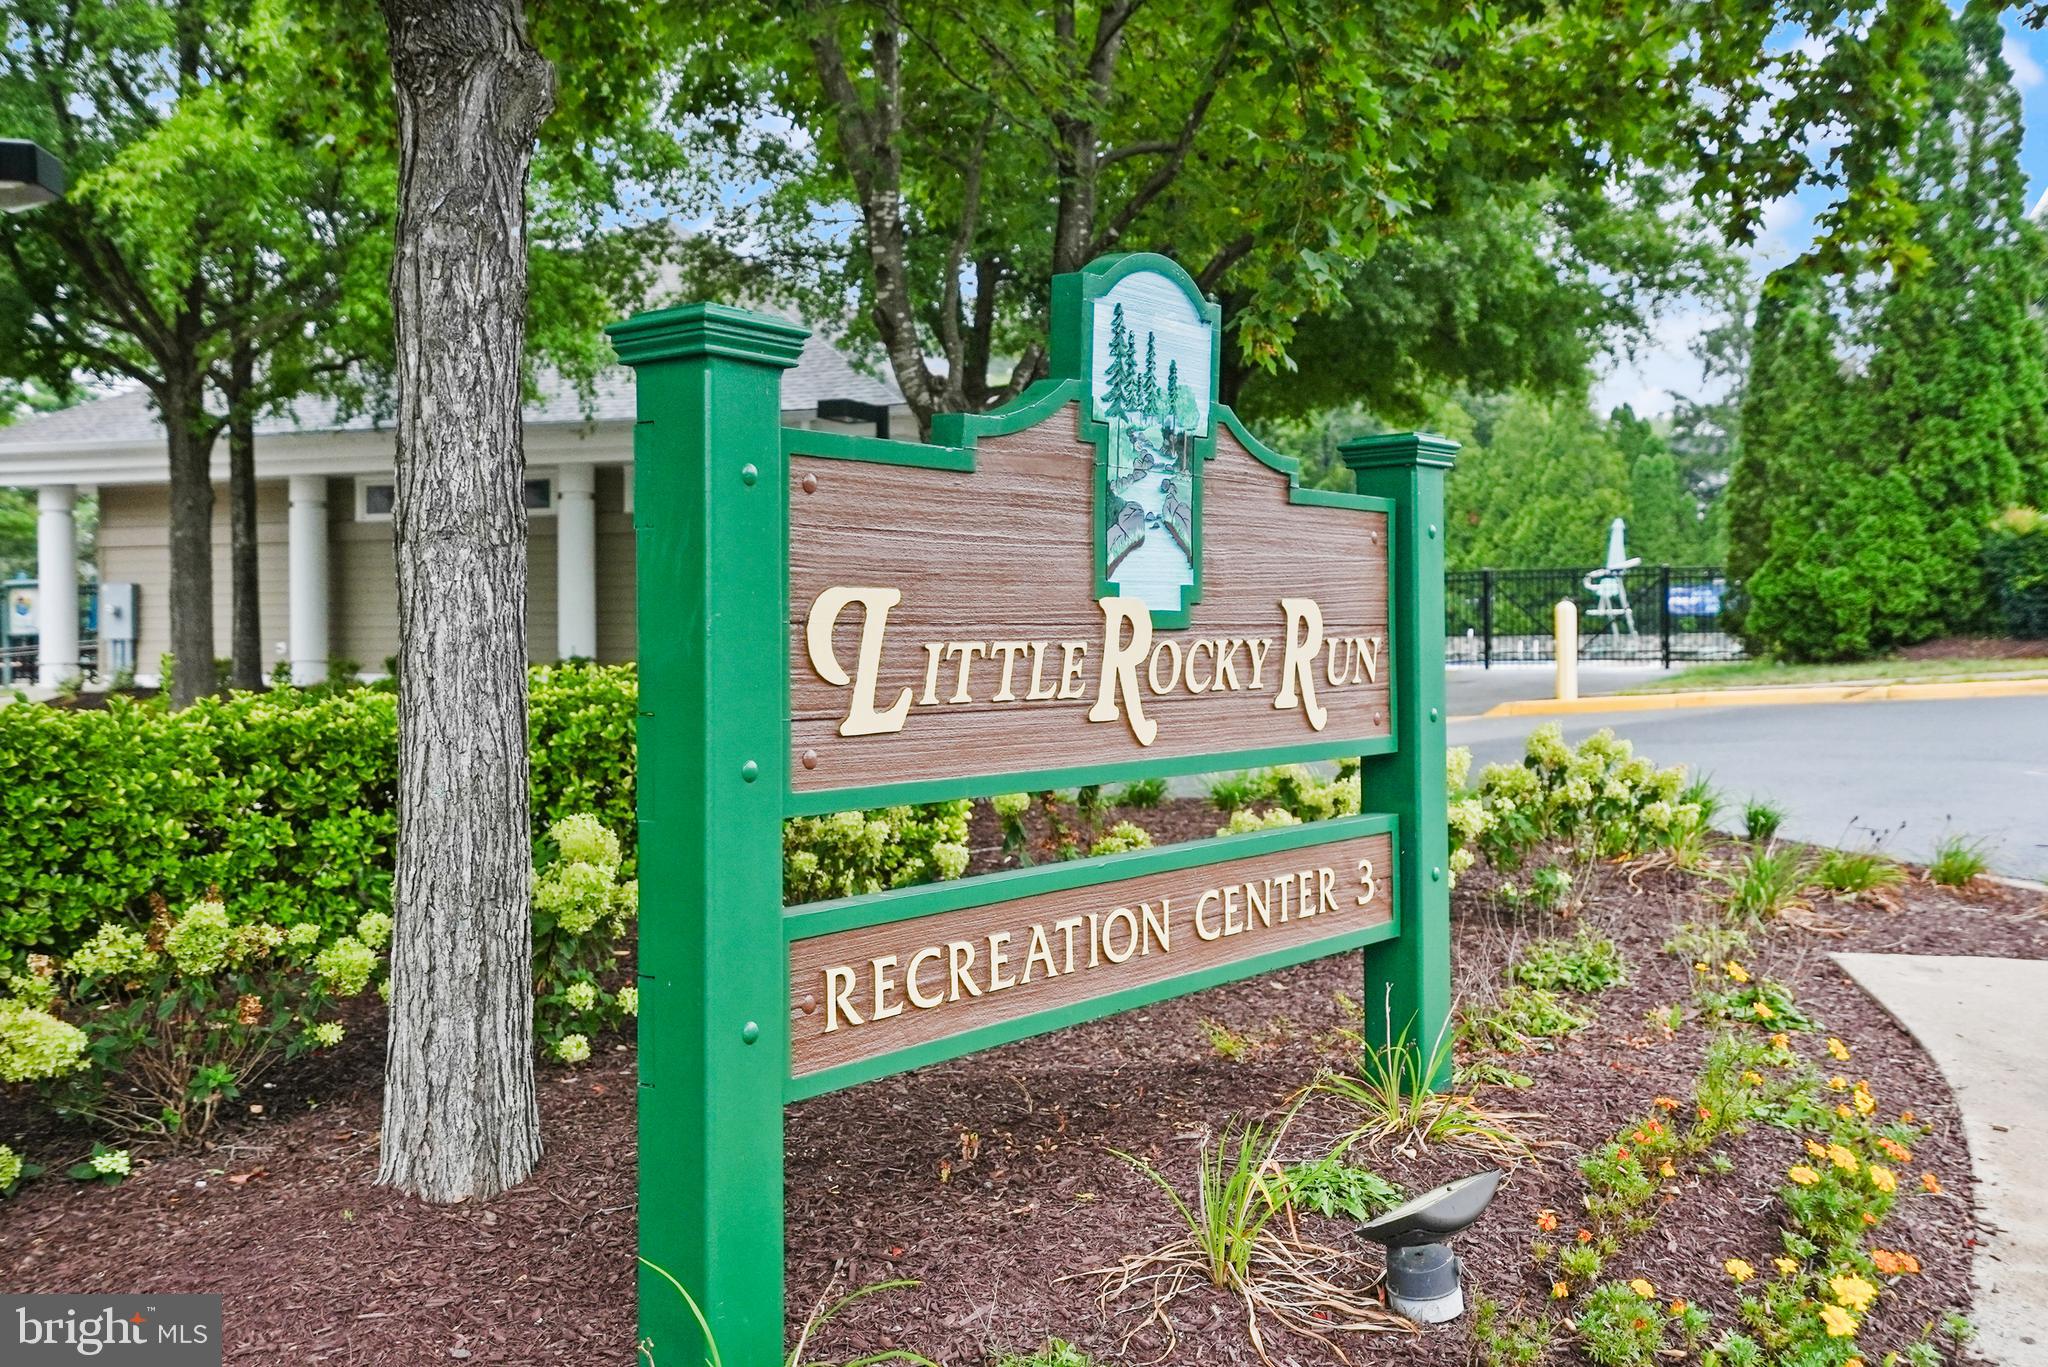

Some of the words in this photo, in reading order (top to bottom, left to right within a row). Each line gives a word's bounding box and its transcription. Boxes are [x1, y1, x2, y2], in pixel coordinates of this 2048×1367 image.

[823, 899, 1170, 1033] RECREATION
[1194, 866, 1338, 941] CENTER
[1356, 858, 1375, 905] 3
